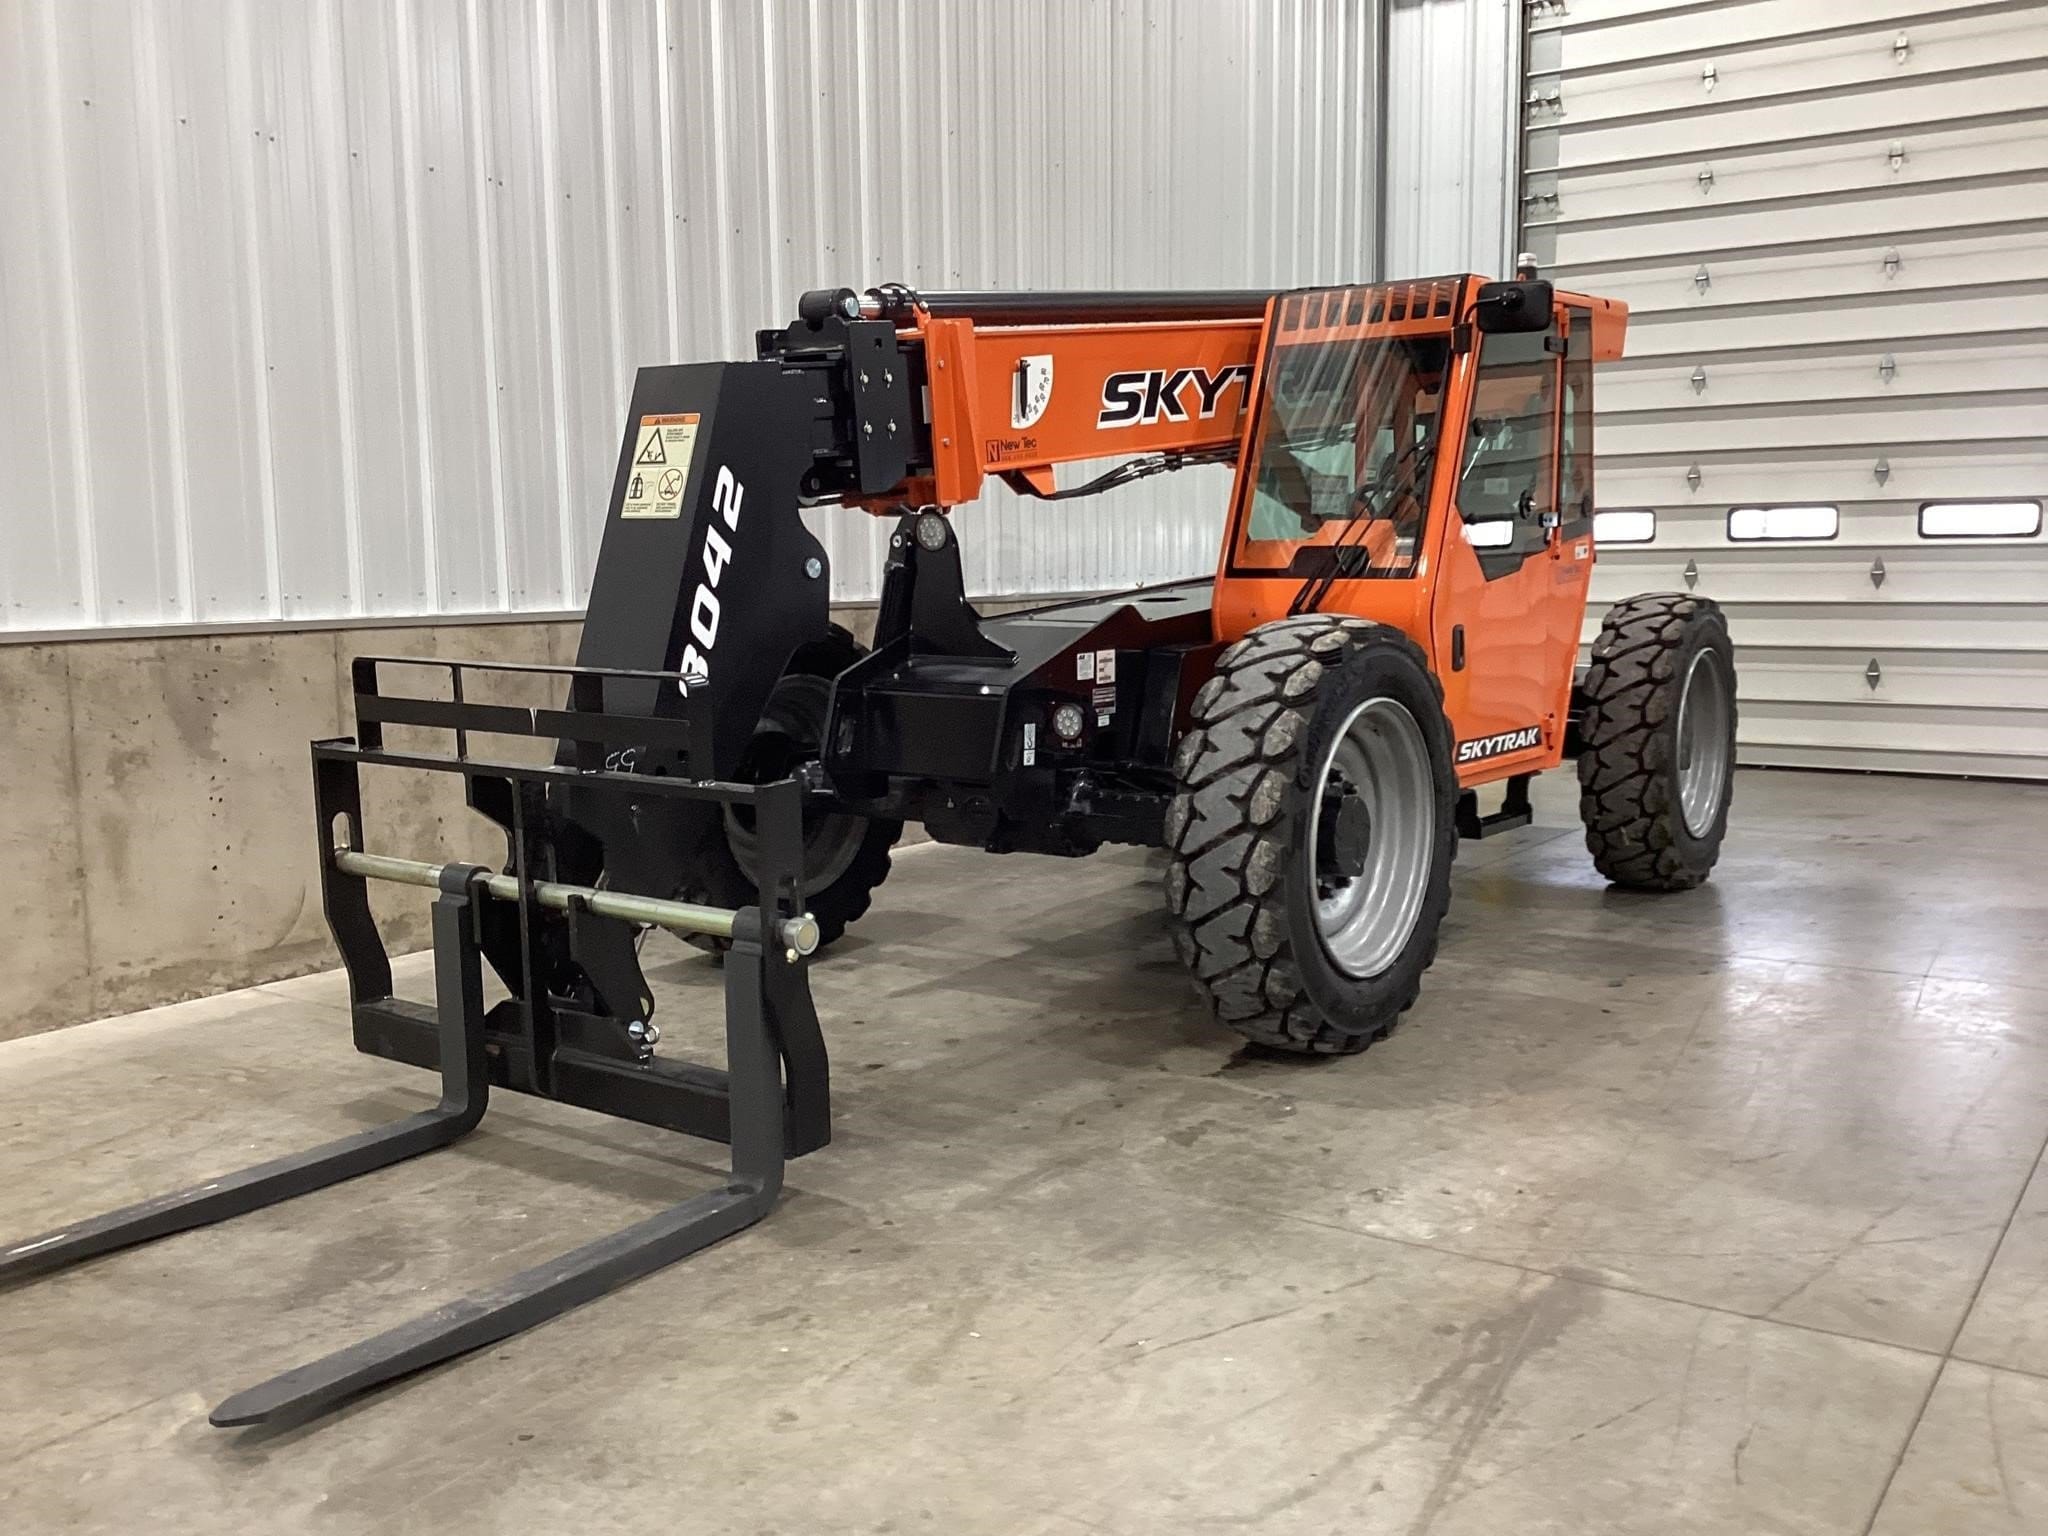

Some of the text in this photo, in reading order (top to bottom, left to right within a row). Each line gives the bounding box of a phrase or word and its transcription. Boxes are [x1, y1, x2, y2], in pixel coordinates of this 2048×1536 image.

[1000, 436, 1037, 451] New Tec
[1458, 728, 1539, 761] SKYTRAK
